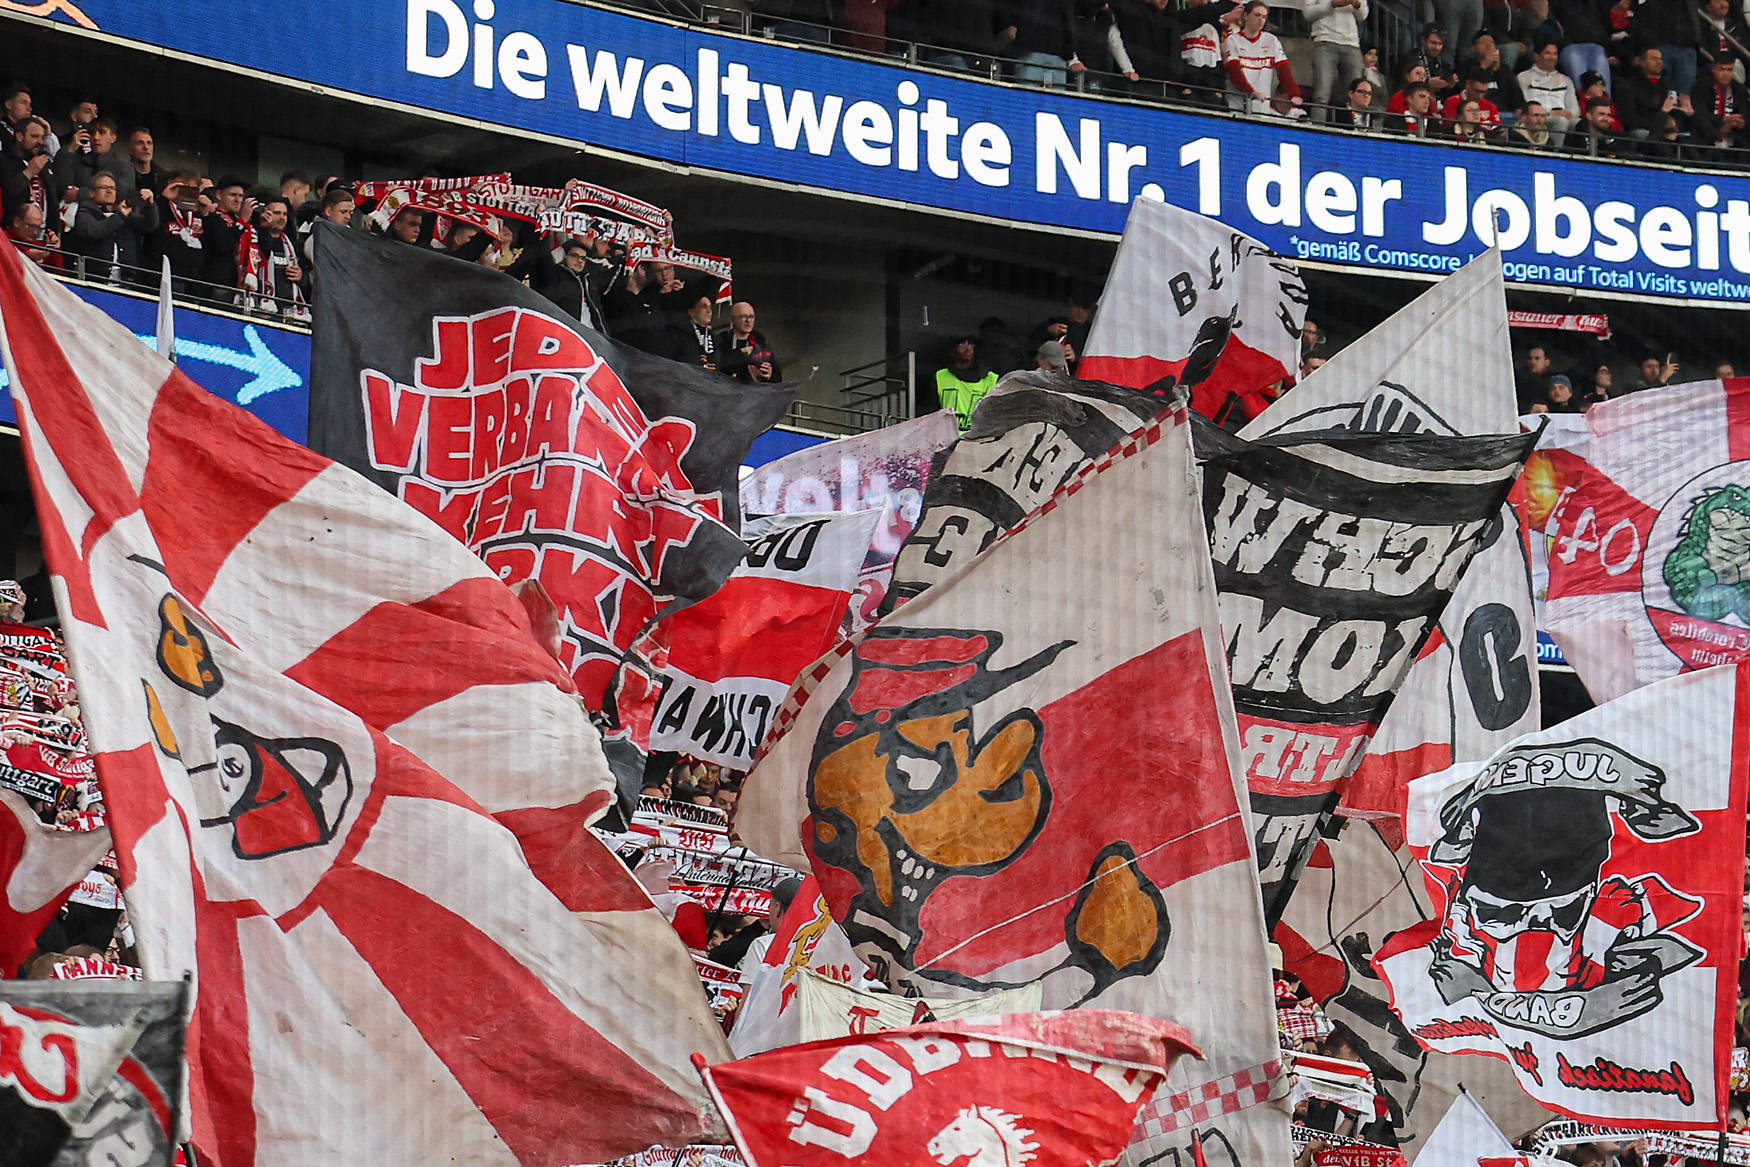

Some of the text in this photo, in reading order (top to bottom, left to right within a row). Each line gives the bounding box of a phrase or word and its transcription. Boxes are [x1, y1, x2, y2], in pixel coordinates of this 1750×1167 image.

[405, 0, 548, 100] Die
[566, 49, 1011, 187] weltweite
[1036, 111, 1166, 204] Nr.
[1179, 138, 1222, 216] 1
[1246, 143, 1402, 237] der
[1554, 264, 1584, 284] auf
[1588, 267, 1634, 289] Total
[1636, 271, 1686, 293] Visits
[399, 461, 702, 585] KEHRT
